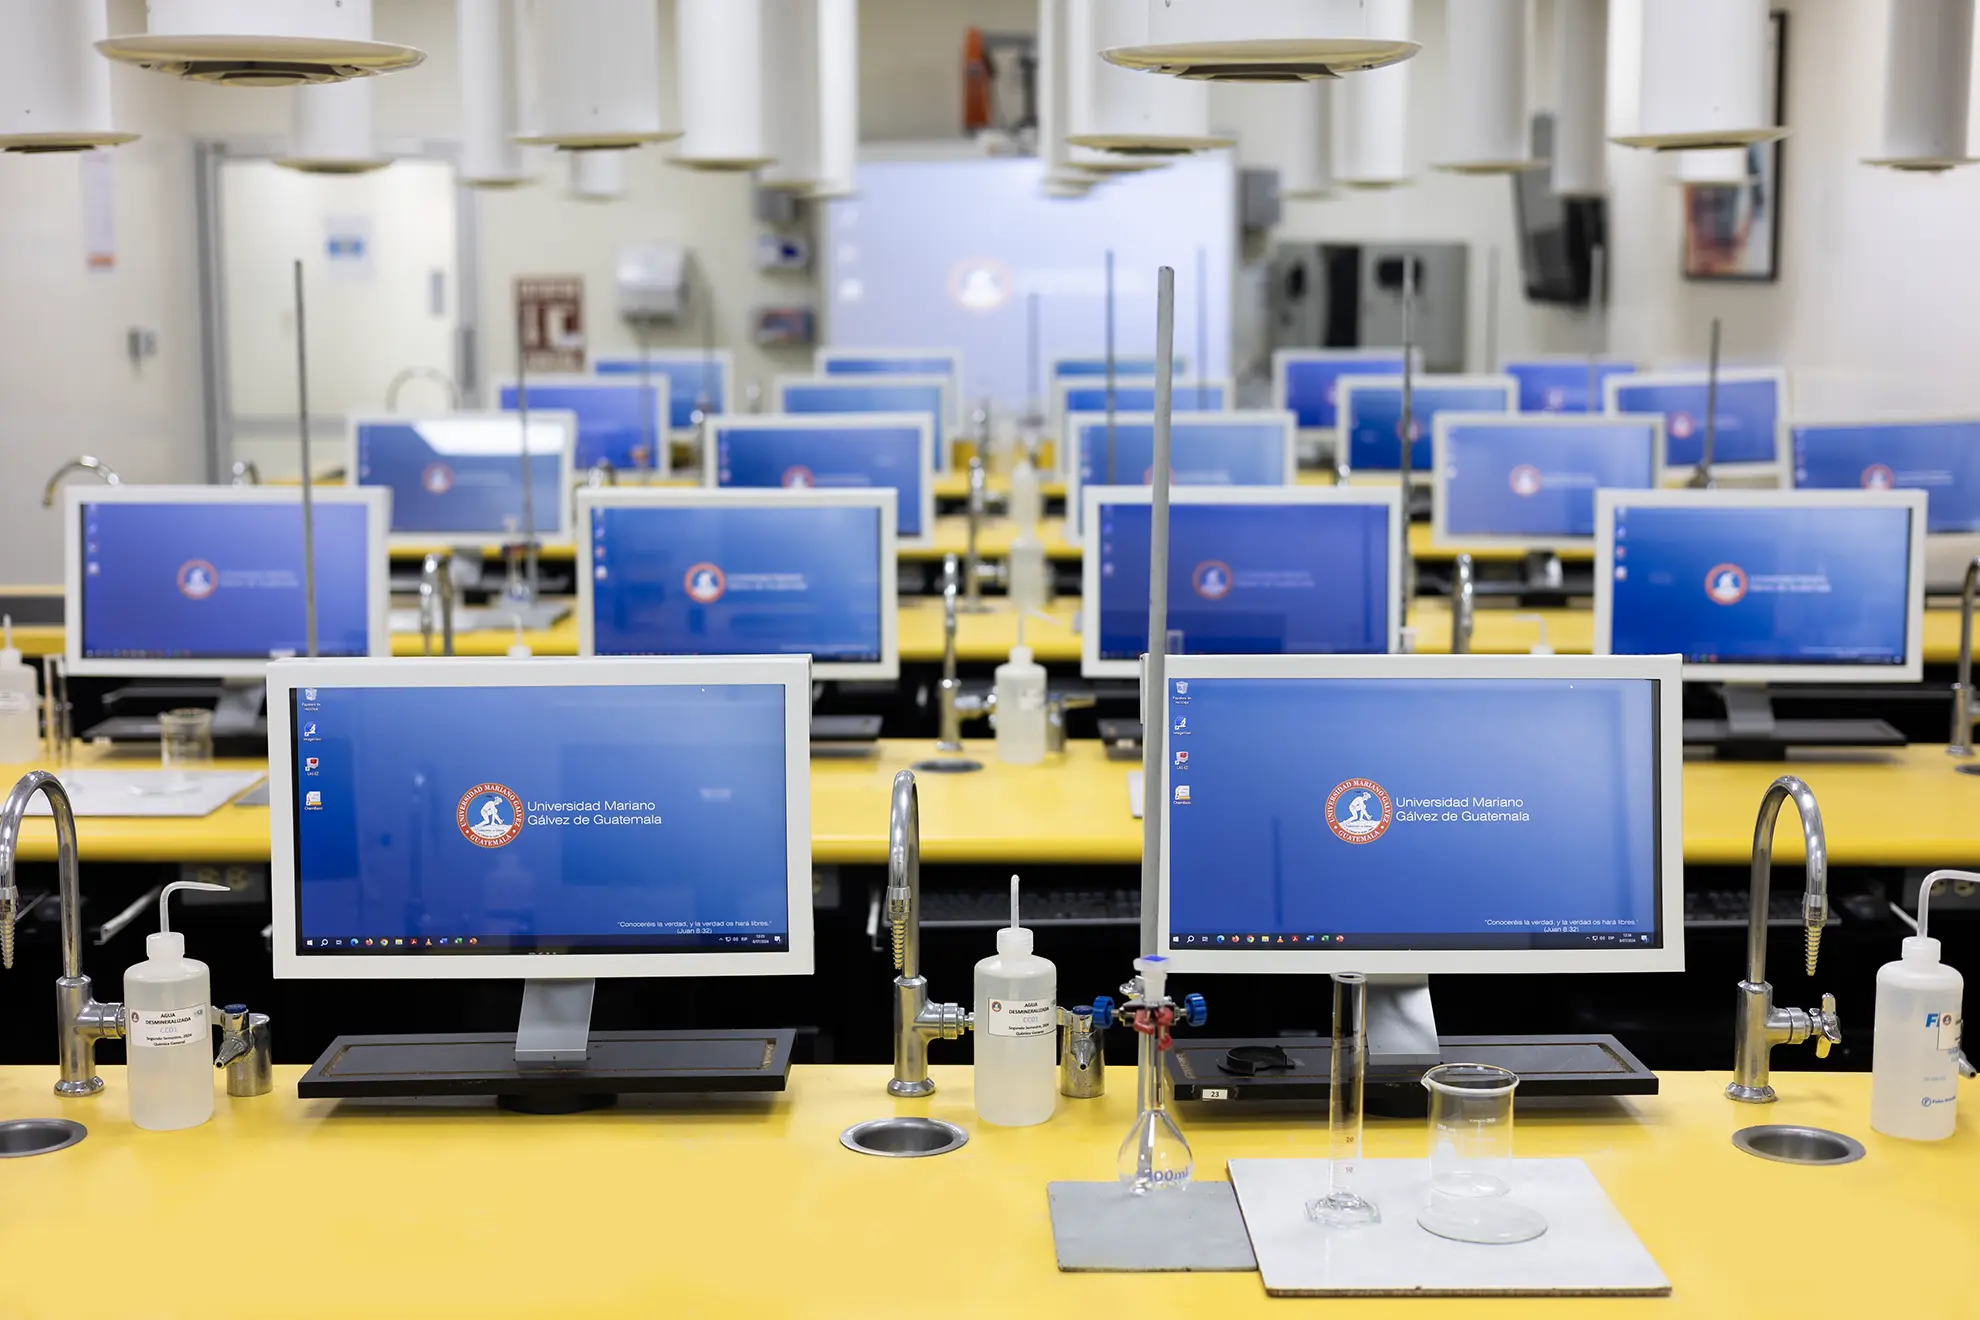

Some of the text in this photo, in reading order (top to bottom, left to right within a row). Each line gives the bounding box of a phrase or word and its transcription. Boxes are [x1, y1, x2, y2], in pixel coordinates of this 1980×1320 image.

[459, 786, 483, 828] UNIVERSIDAD
[484, 784, 516, 800] MARIANO
[528, 801, 655, 811] Universidad Mariano
[1328, 782, 1352, 823] UNIVERSIDAD
[1353, 780, 1384, 796] MARIANO
[1396, 797, 1524, 808] Universidad Mariano
[528, 814, 662, 826] Gálvez de Guatemala
[1396, 810, 1530, 822] Gálvez de Guatemala
[470, 834, 511, 846] GUATEMALA
[1338, 830, 1380, 842] GUATEMALA
